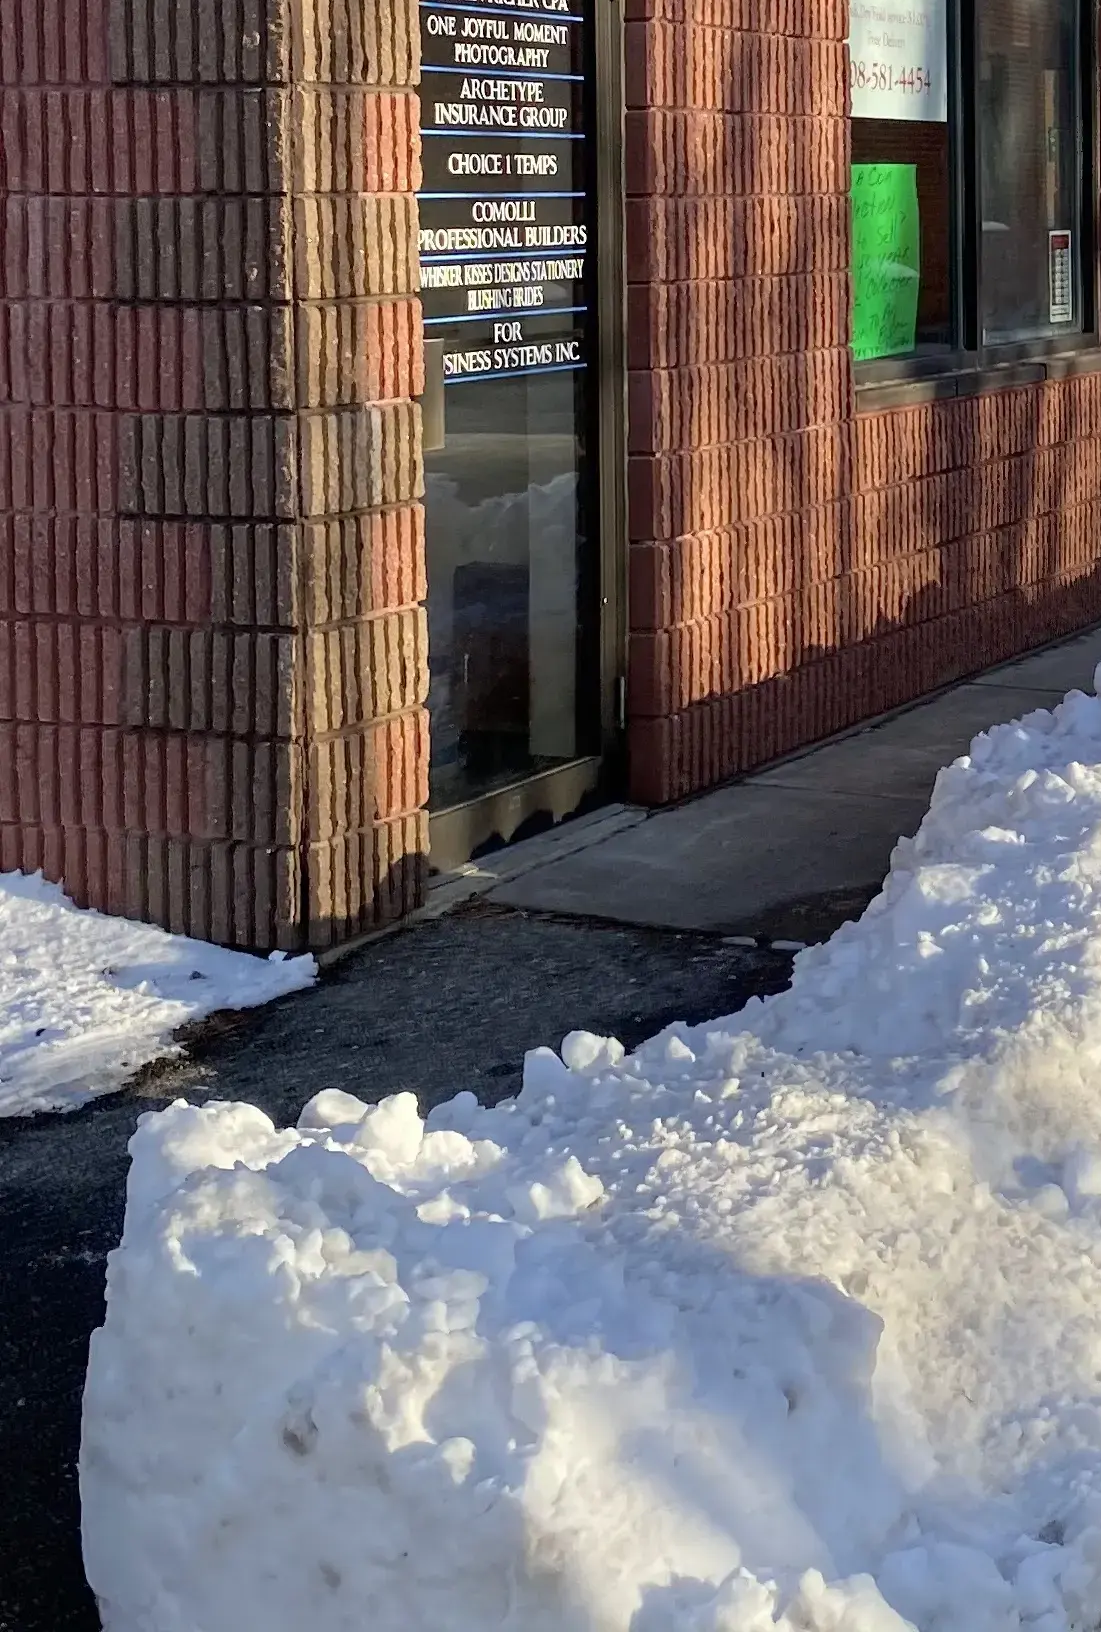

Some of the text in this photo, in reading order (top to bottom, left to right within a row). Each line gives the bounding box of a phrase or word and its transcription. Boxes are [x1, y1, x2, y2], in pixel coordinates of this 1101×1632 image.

[427, 15, 568, 44] ONE JOYFUL MOMENT
[454, 43, 550, 68] PHOTOGRAPHY
[460, 78, 544, 102] ARCHETYPE
[434, 103, 568, 128] INSURANCE GROUP
[448, 153, 502, 175] CHOICE
[514, 154, 559, 175] TEMPS
[472, 201, 536, 222] COMOLLI
[417, 225, 587, 251] PROFESSIONAL BUILDERS
[420, 259, 584, 288] WHISKER KISSES DESIGNS STATIONERY
[467, 285, 544, 311] BLUSHING BRIDES
[494, 321, 523, 344] FOR
[443, 341, 581, 375] SINESS SYSTEMS INC
